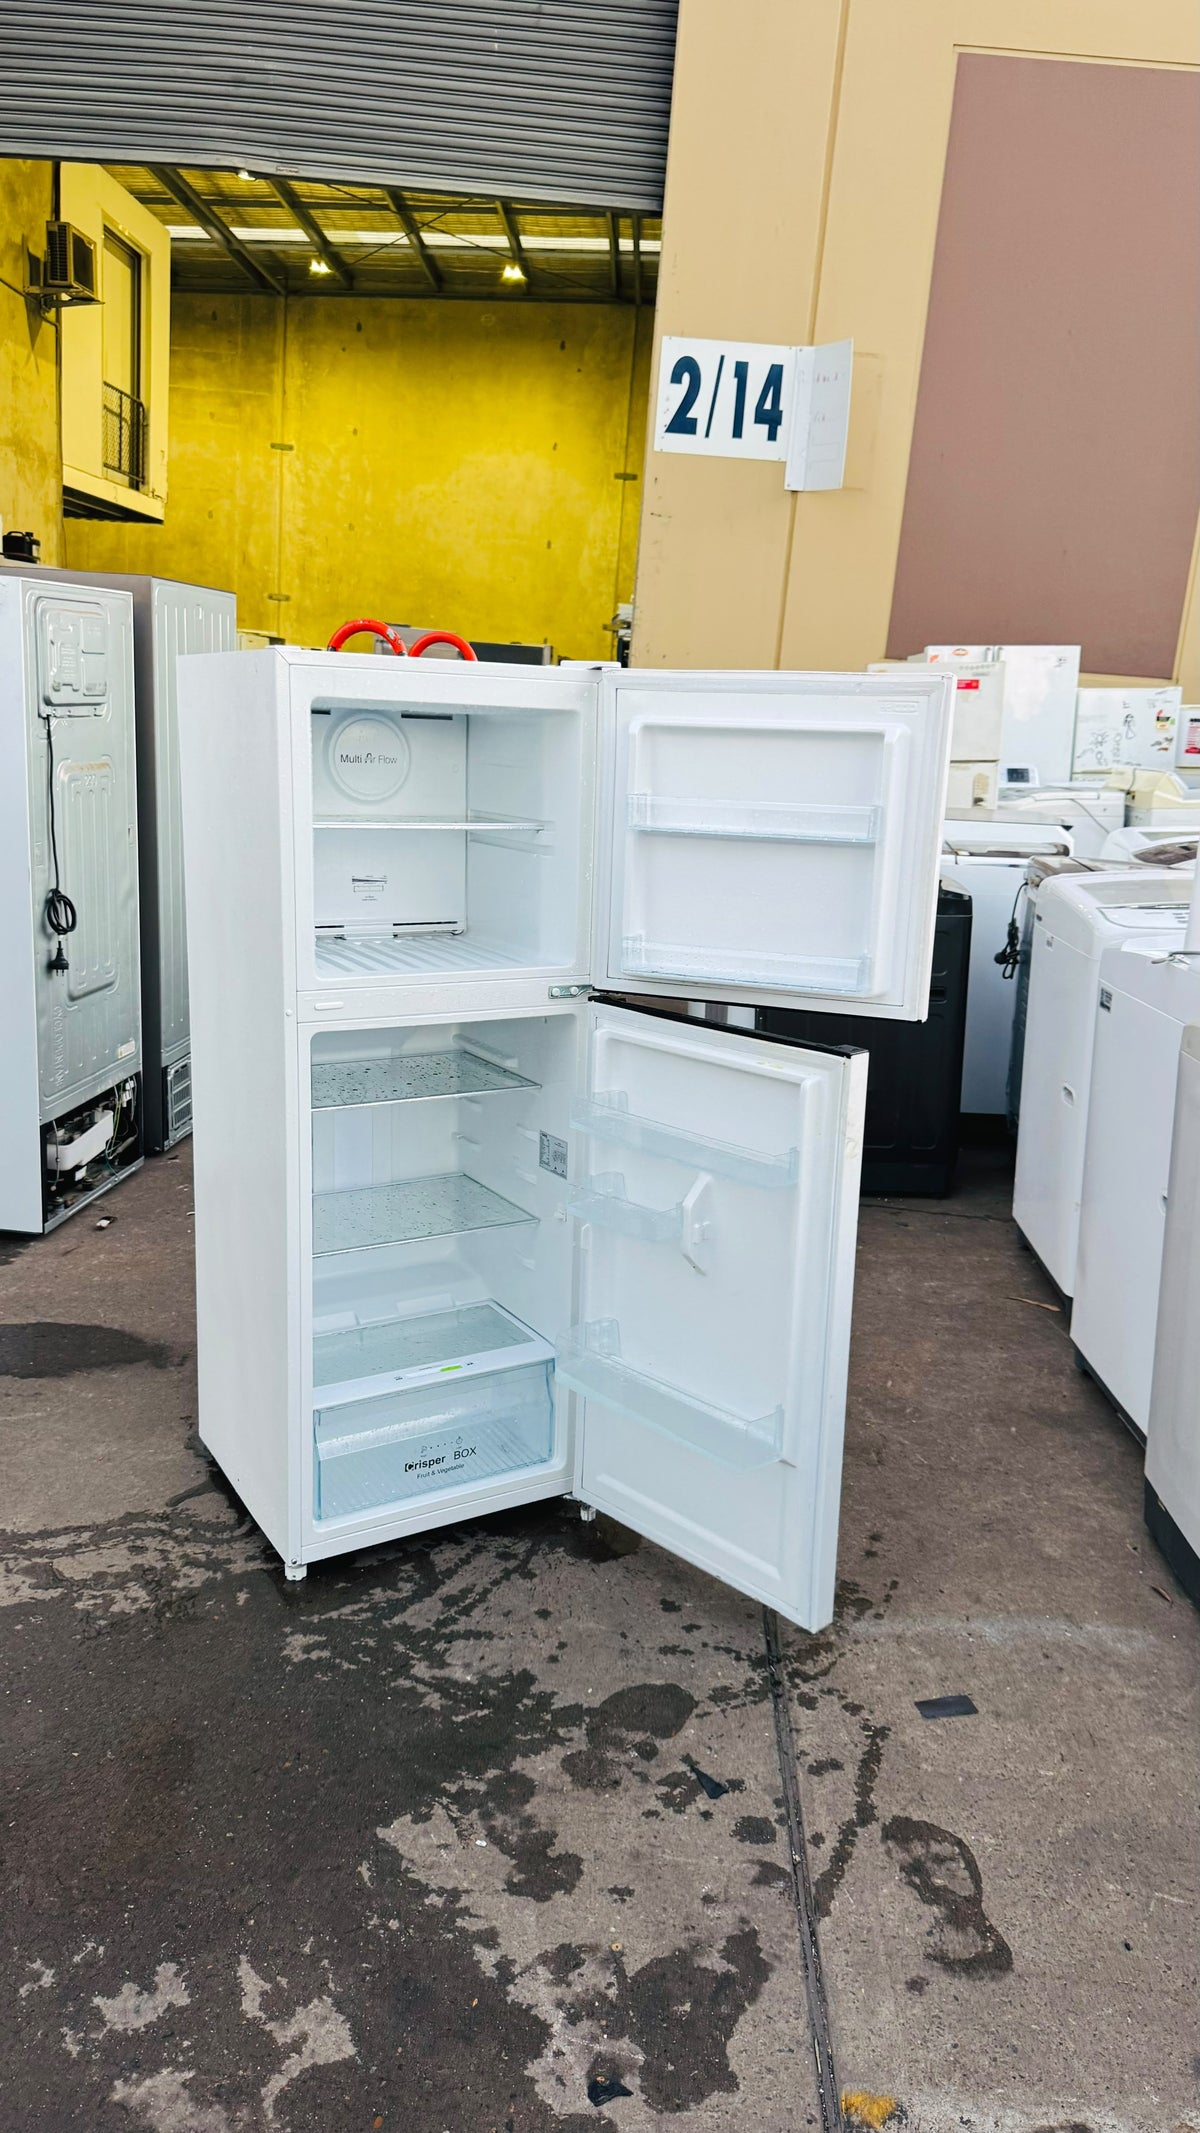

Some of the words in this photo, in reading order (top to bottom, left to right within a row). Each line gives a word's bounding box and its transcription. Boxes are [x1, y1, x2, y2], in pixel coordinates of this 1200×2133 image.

[664, 354, 784, 442] 2/14
[340, 754, 362, 764] Multi
[378, 754, 398, 764] Flow
[404, 1455, 446, 1473] Crisper
[453, 1446, 477, 1461] BOX
